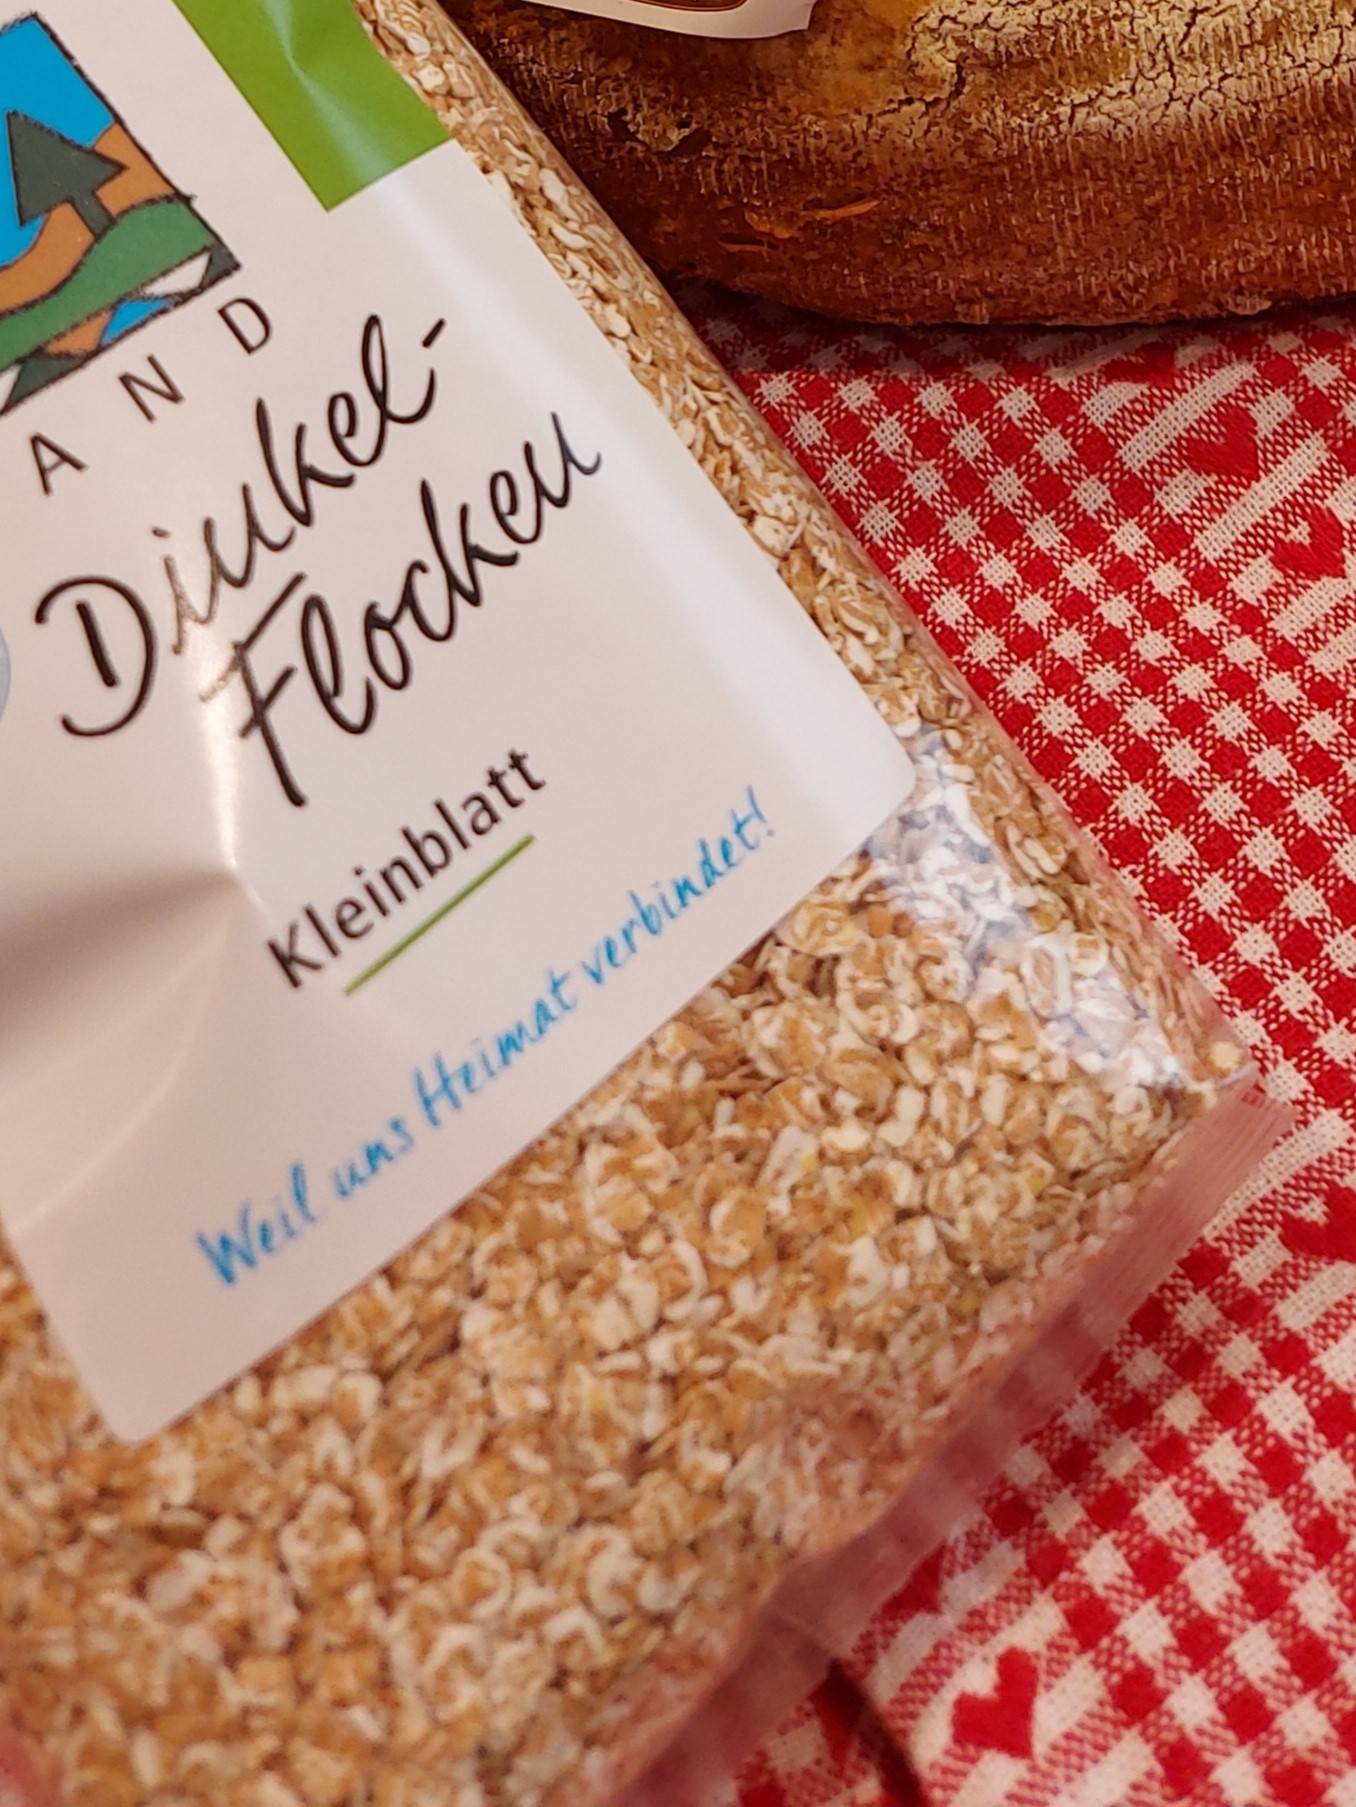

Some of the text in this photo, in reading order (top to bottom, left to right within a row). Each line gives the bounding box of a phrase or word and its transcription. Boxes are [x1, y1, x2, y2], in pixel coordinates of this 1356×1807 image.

[200, 412, 602, 808] Flocken
[195, 785, 777, 1290] Weil uns Heimat verbindet!
[265, 748, 547, 989] Kleinblatt
